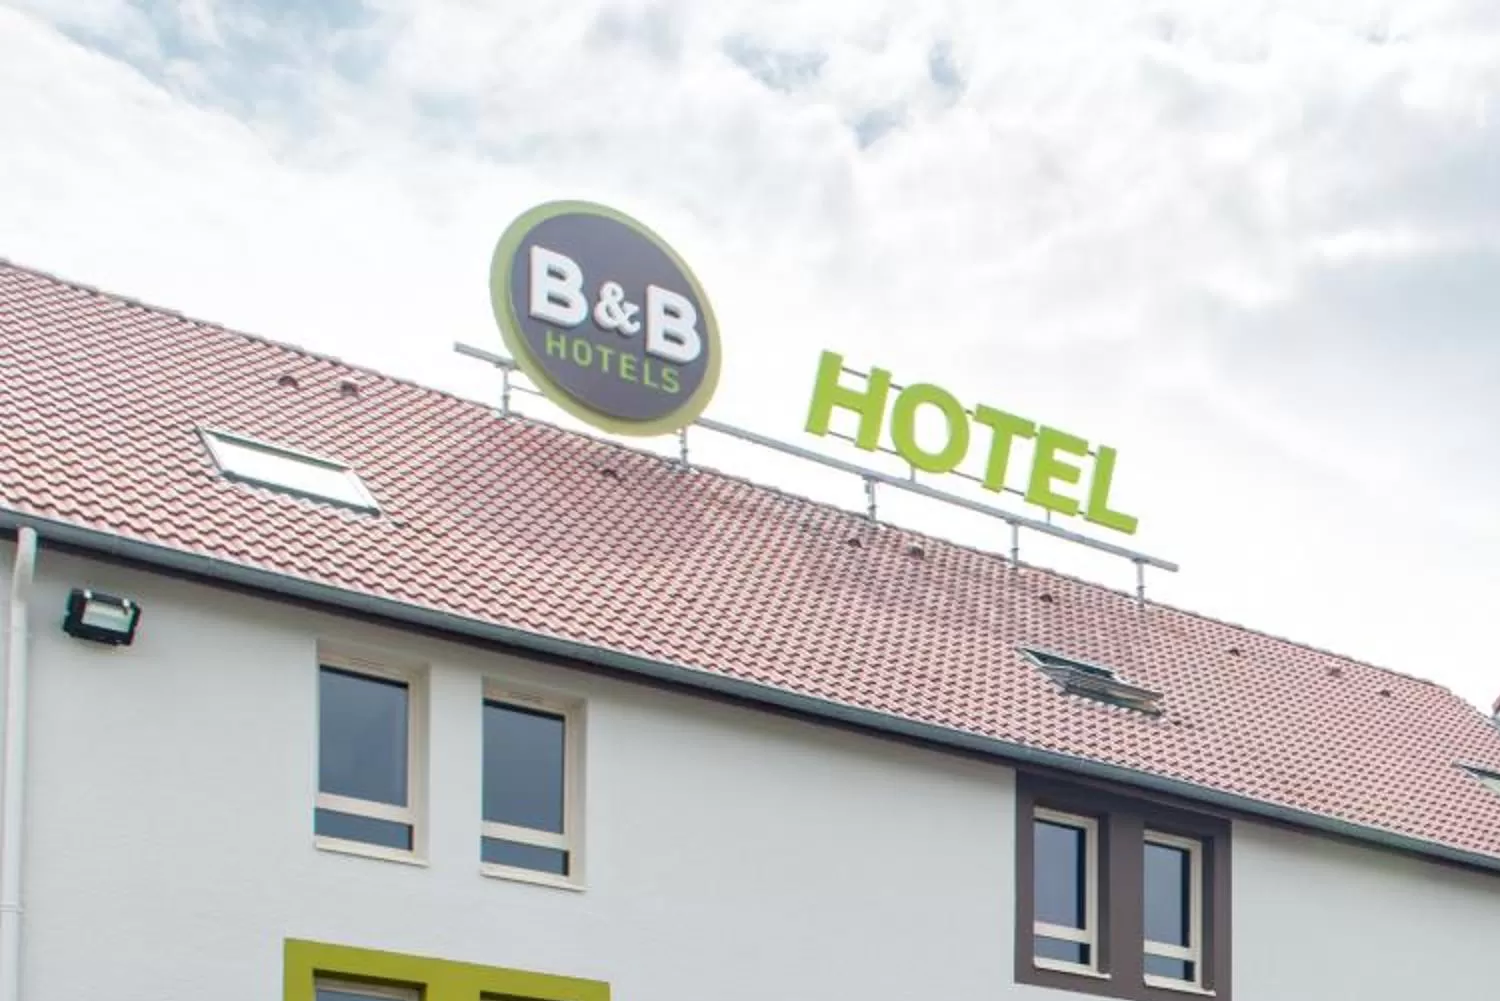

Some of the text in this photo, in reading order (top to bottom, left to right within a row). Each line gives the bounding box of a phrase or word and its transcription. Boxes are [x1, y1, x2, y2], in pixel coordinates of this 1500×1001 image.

[529, 245, 701, 363] B&B
[545, 330, 681, 394] HOTELS
[805, 350, 1138, 535] HOTEL
